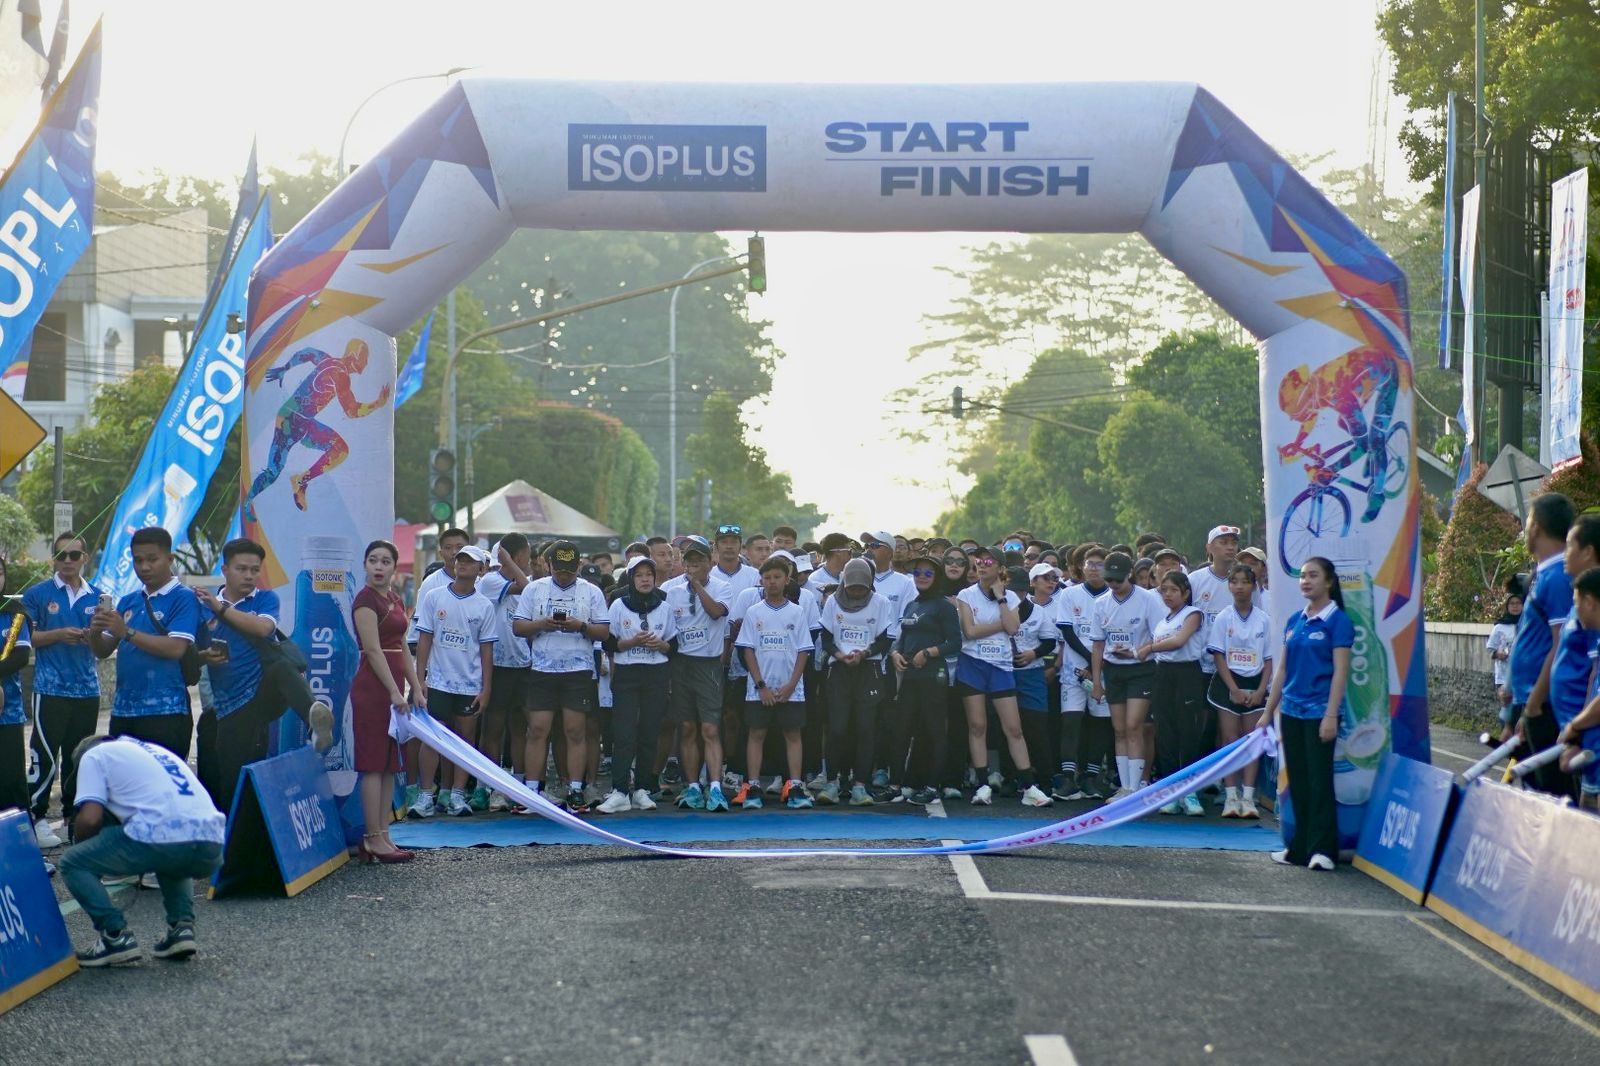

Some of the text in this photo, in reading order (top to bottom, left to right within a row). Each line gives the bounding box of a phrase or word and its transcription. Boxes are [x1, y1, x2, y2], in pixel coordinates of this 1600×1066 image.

[825, 121, 1030, 153] START
[582, 143, 756, 183] ISOPLUS
[880, 165, 1090, 197] FINISH
[288, 794, 326, 851] ISOPLUS
[1379, 799, 1421, 849] ISOPLUS
